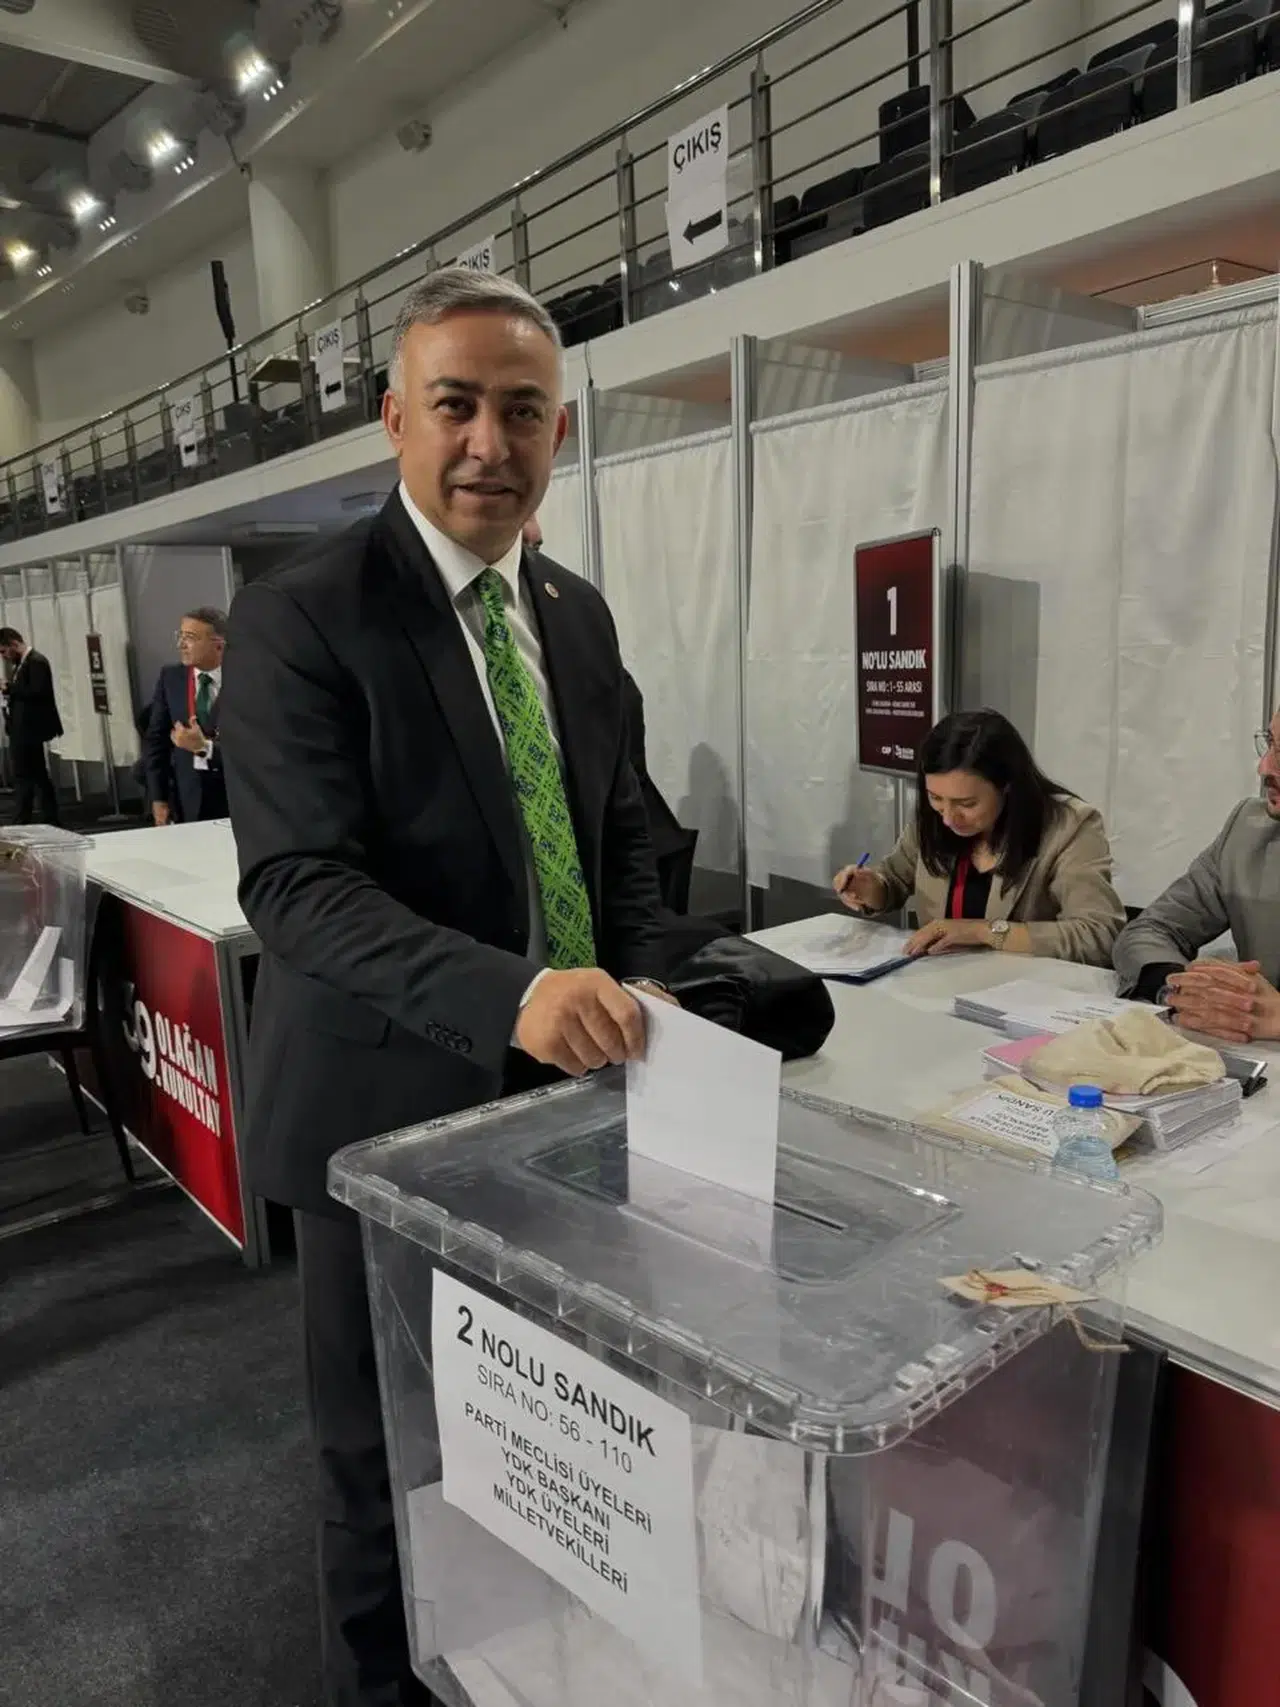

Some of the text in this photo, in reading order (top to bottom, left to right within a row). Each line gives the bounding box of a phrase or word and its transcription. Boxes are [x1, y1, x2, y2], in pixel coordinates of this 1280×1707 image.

[673, 121, 722, 175] ÇIKIŞ
[887, 586, 897, 635] 1
[889, 649, 926, 669] SANDIK
[155, 1011, 219, 1097] OLAĞAN
[160, 1057, 220, 1138] KURULTAY
[457, 1305, 657, 1458] 2 NOLU SANDIK
[478, 1363, 517, 1405] SIRA
[521, 1389, 553, 1428] NO:
[559, 1413, 581, 1443] 56
[600, 1437, 633, 1474] 110
[465, 1401, 653, 1536] PARTİ MECLİSİ ÜYELERİ
[501, 1445, 611, 1531] YDK BAŞKANI
[493, 1482, 629, 1594] MİLLETVEKİLLERİ
[506, 1469, 610, 1556] YDK ÜYELERİ
